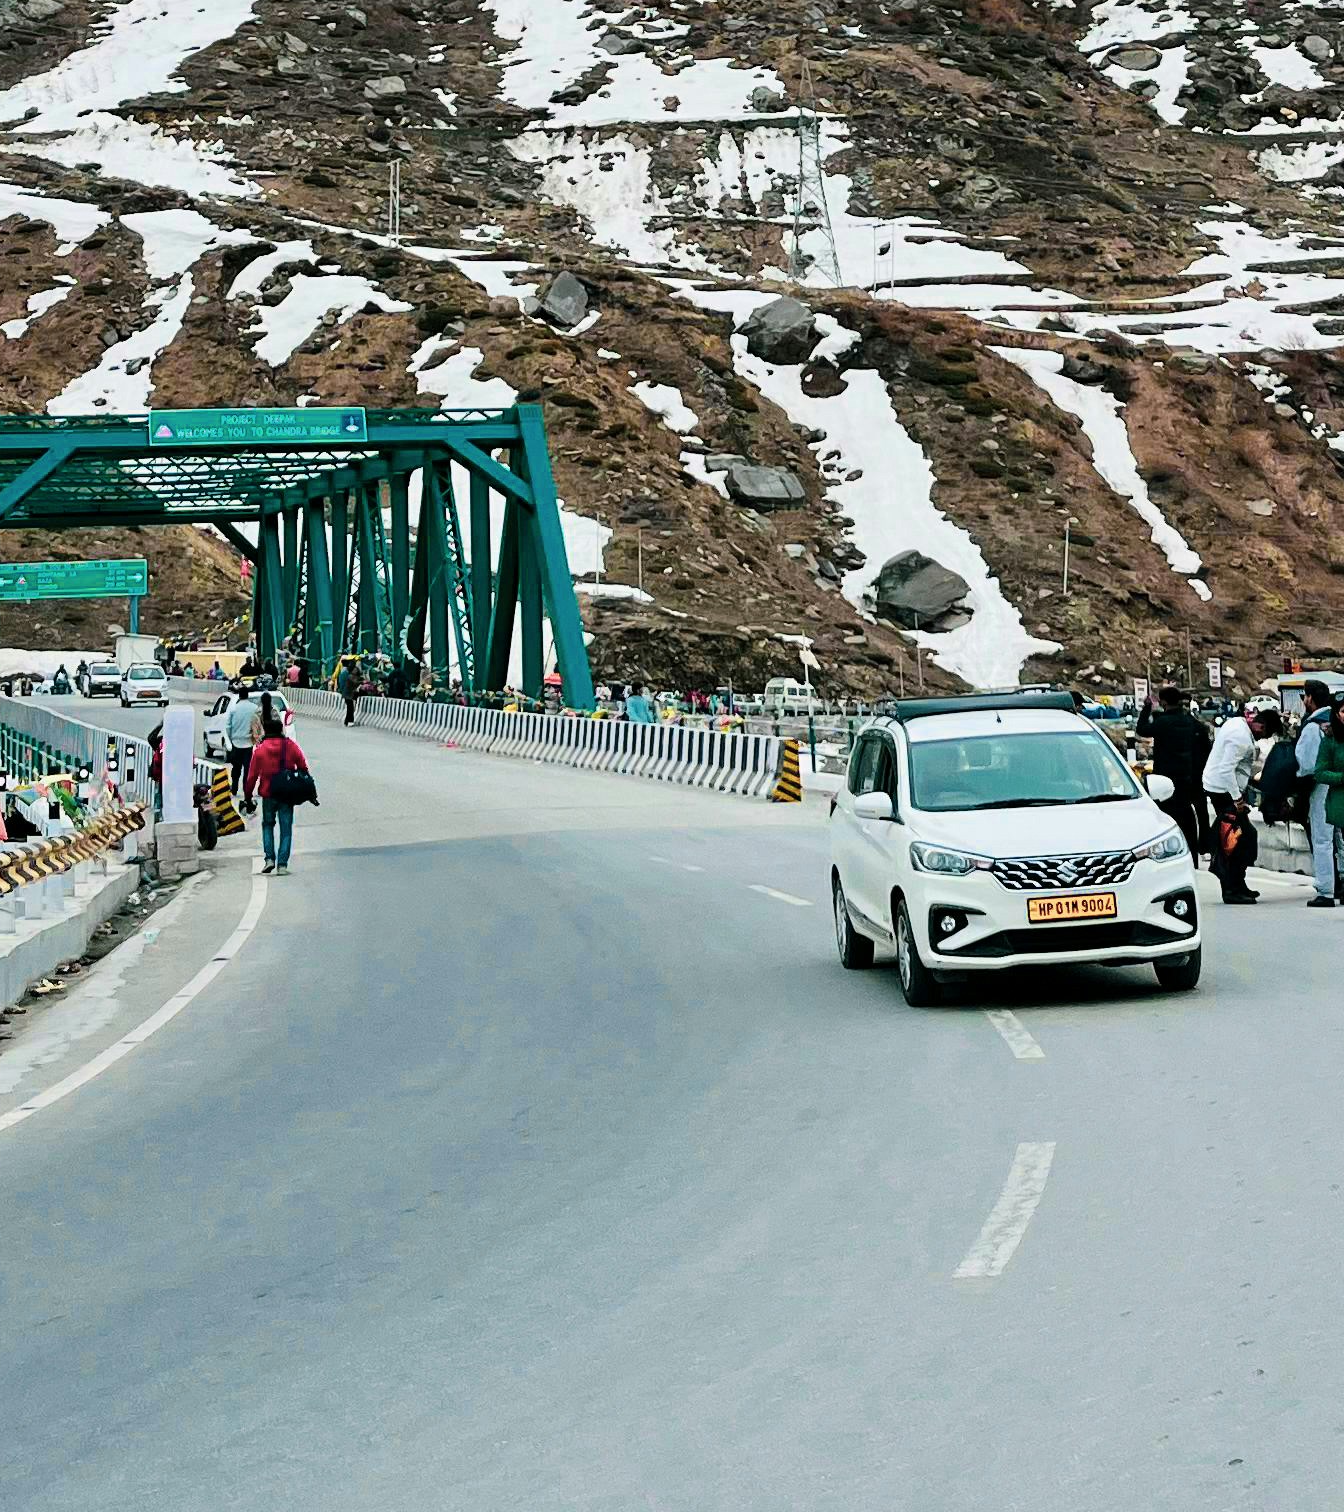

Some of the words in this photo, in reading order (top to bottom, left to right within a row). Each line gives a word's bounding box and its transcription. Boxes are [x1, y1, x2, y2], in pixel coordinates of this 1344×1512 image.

[221, 414, 256, 424] PROJECT
[176, 428, 224, 438] WELCOMES
[228, 427, 246, 437] YOU
[251, 427, 264, 437] TO
[266, 426, 308, 437] CHANDRA
